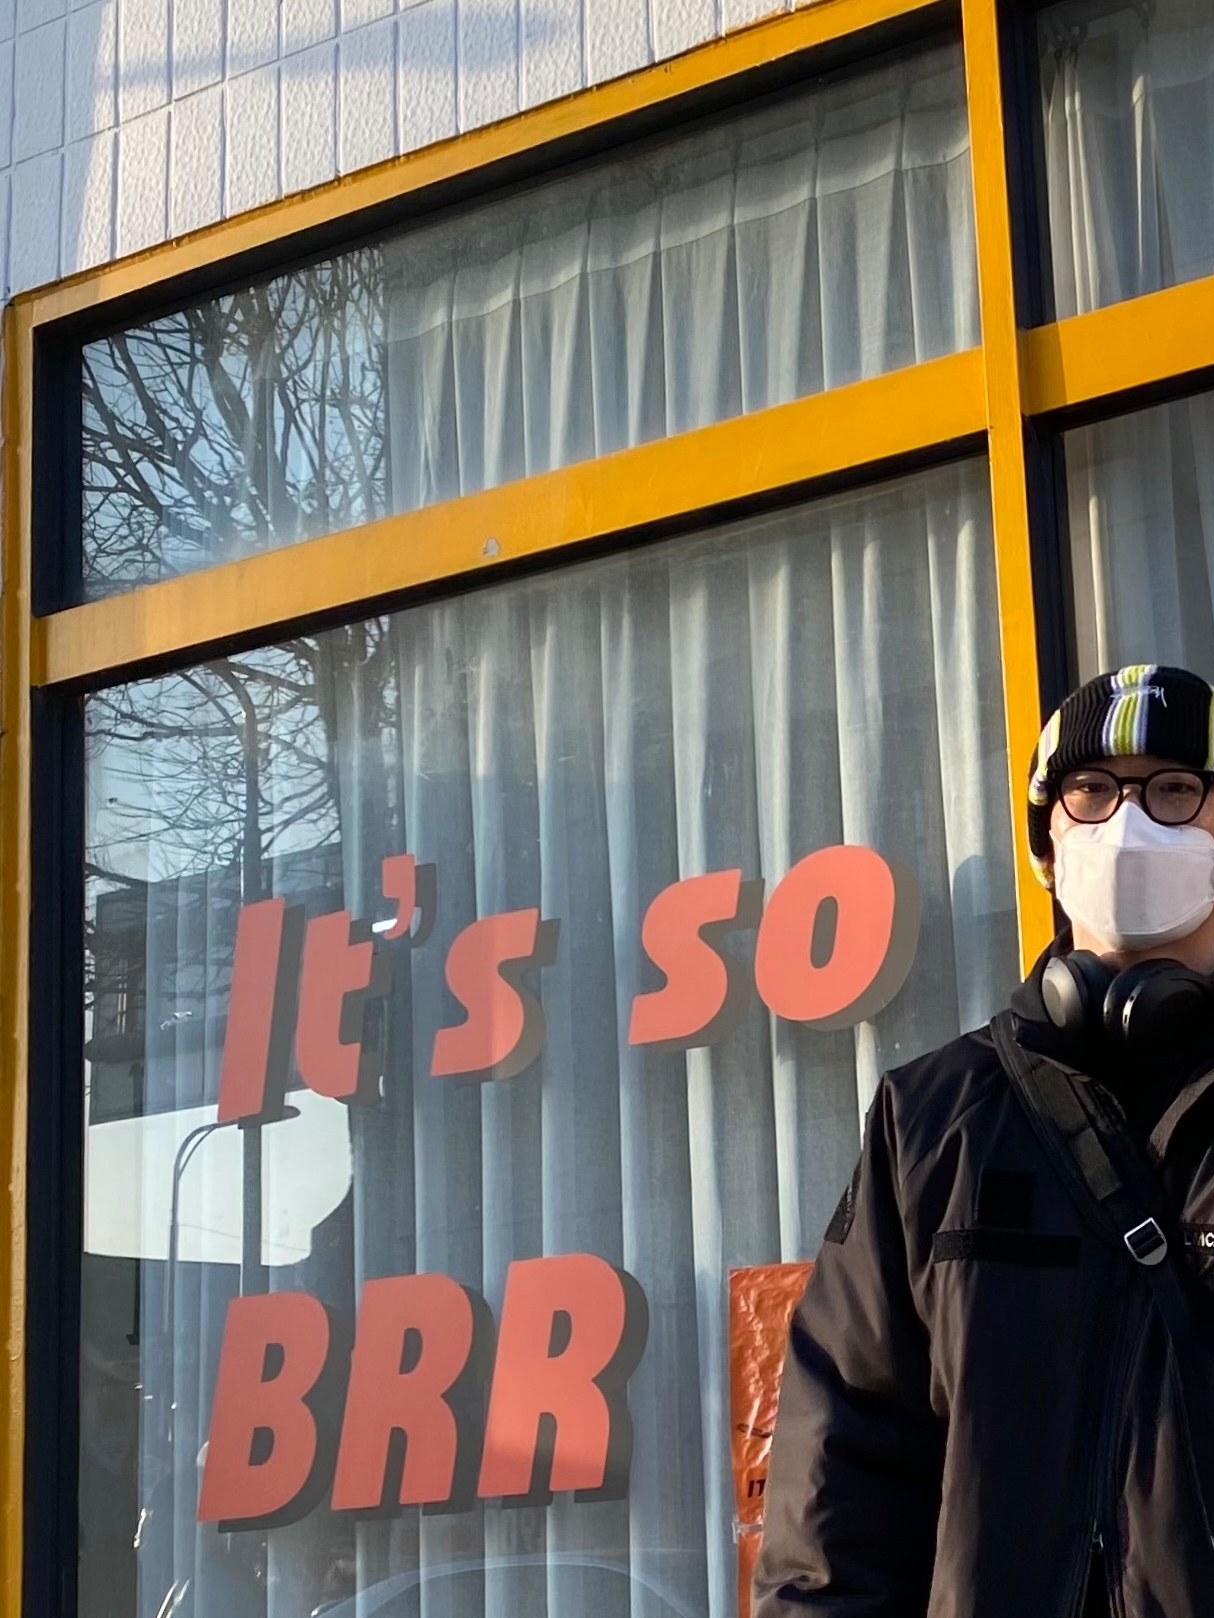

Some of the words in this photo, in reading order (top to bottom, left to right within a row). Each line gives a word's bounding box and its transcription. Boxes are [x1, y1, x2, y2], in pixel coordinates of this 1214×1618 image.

[217, 854, 539, 1122] It's
[628, 843, 898, 1046] so
[196, 1252, 628, 1521] BRR
